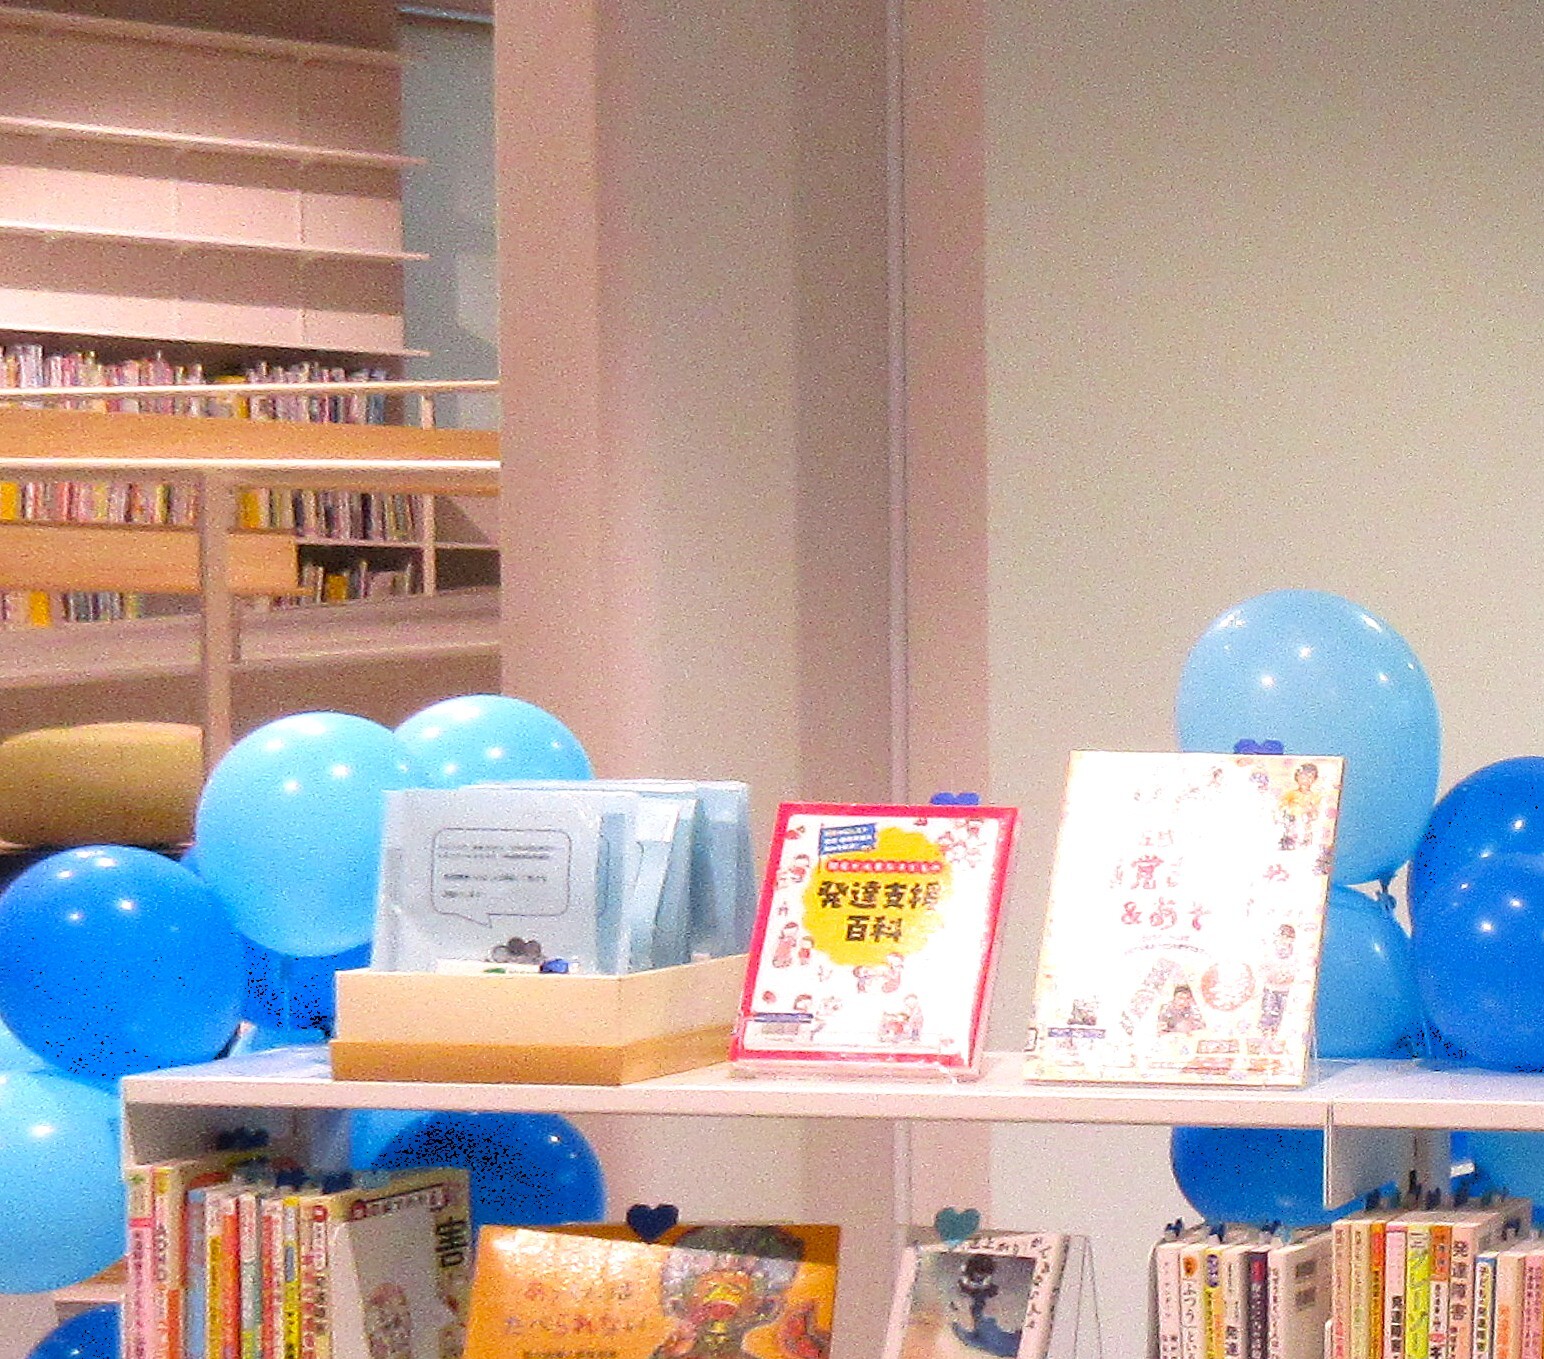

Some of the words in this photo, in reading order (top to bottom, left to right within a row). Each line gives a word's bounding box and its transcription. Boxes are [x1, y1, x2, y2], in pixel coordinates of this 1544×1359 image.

[817, 880, 942, 912] 発達支援
[845, 914, 903, 944] 百科
